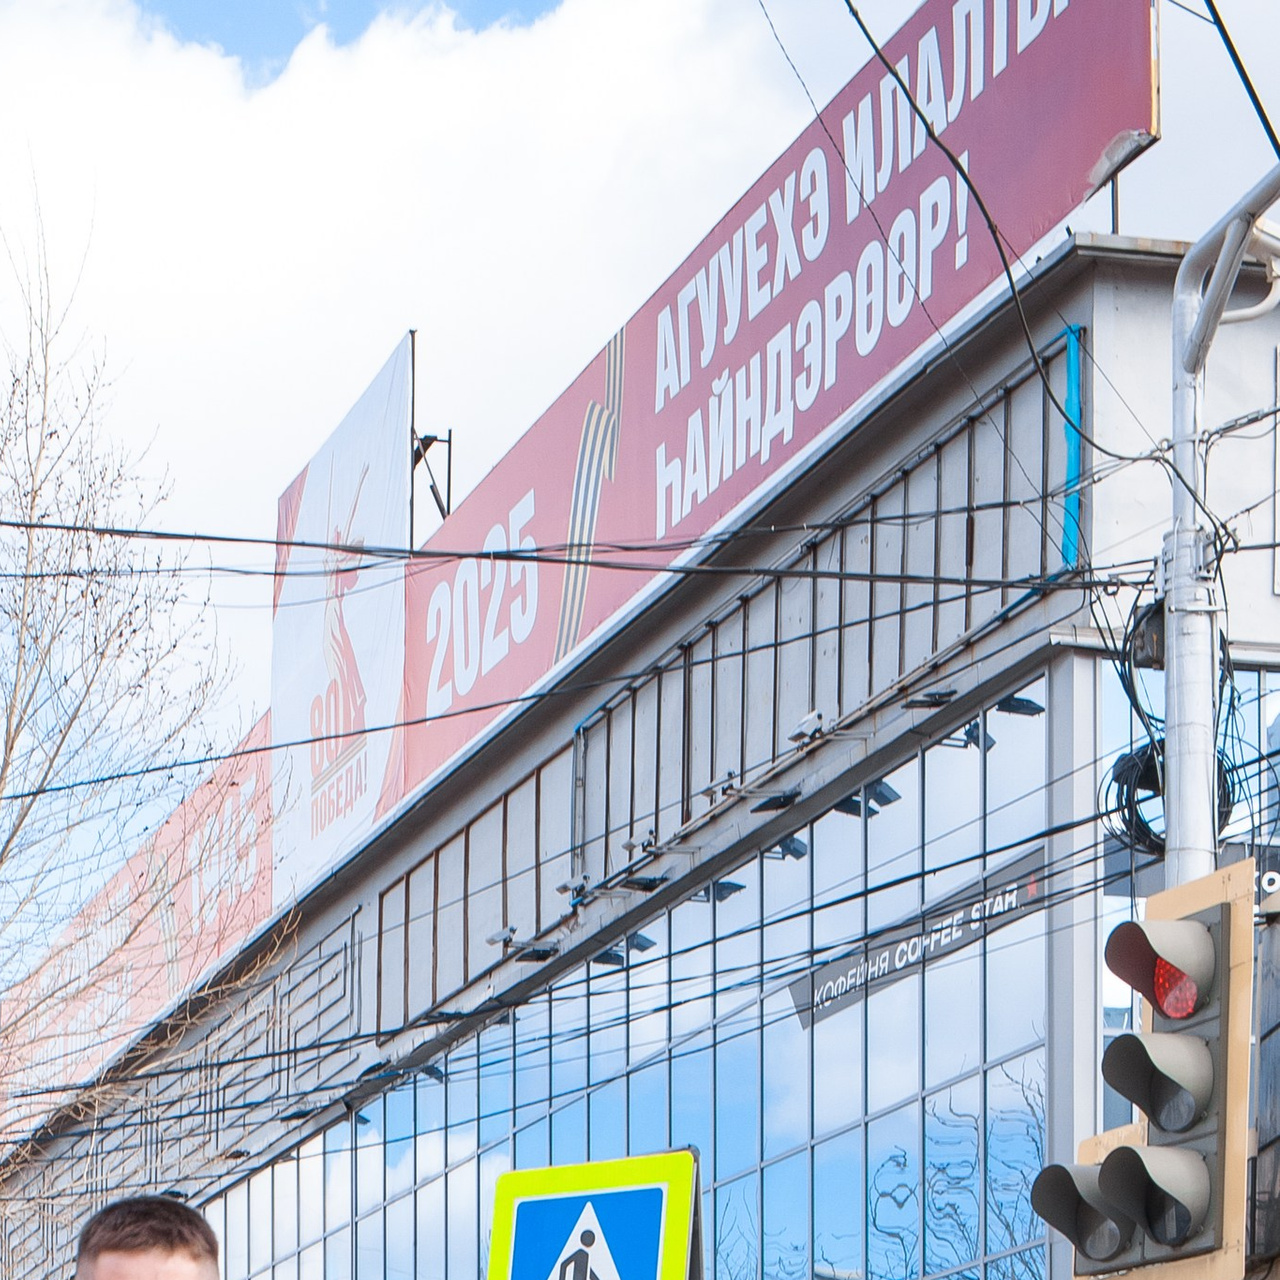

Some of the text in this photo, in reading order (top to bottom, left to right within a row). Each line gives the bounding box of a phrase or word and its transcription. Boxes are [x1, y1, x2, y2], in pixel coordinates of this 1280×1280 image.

[655, 147, 830, 414] АГУУЕХЭ
[426, 488, 539, 727] 2025
[311, 750, 368, 840] ПОБЕДА!
[895, 911, 965, 969] COFFEE
[970, 883, 1022, 930] STAR
